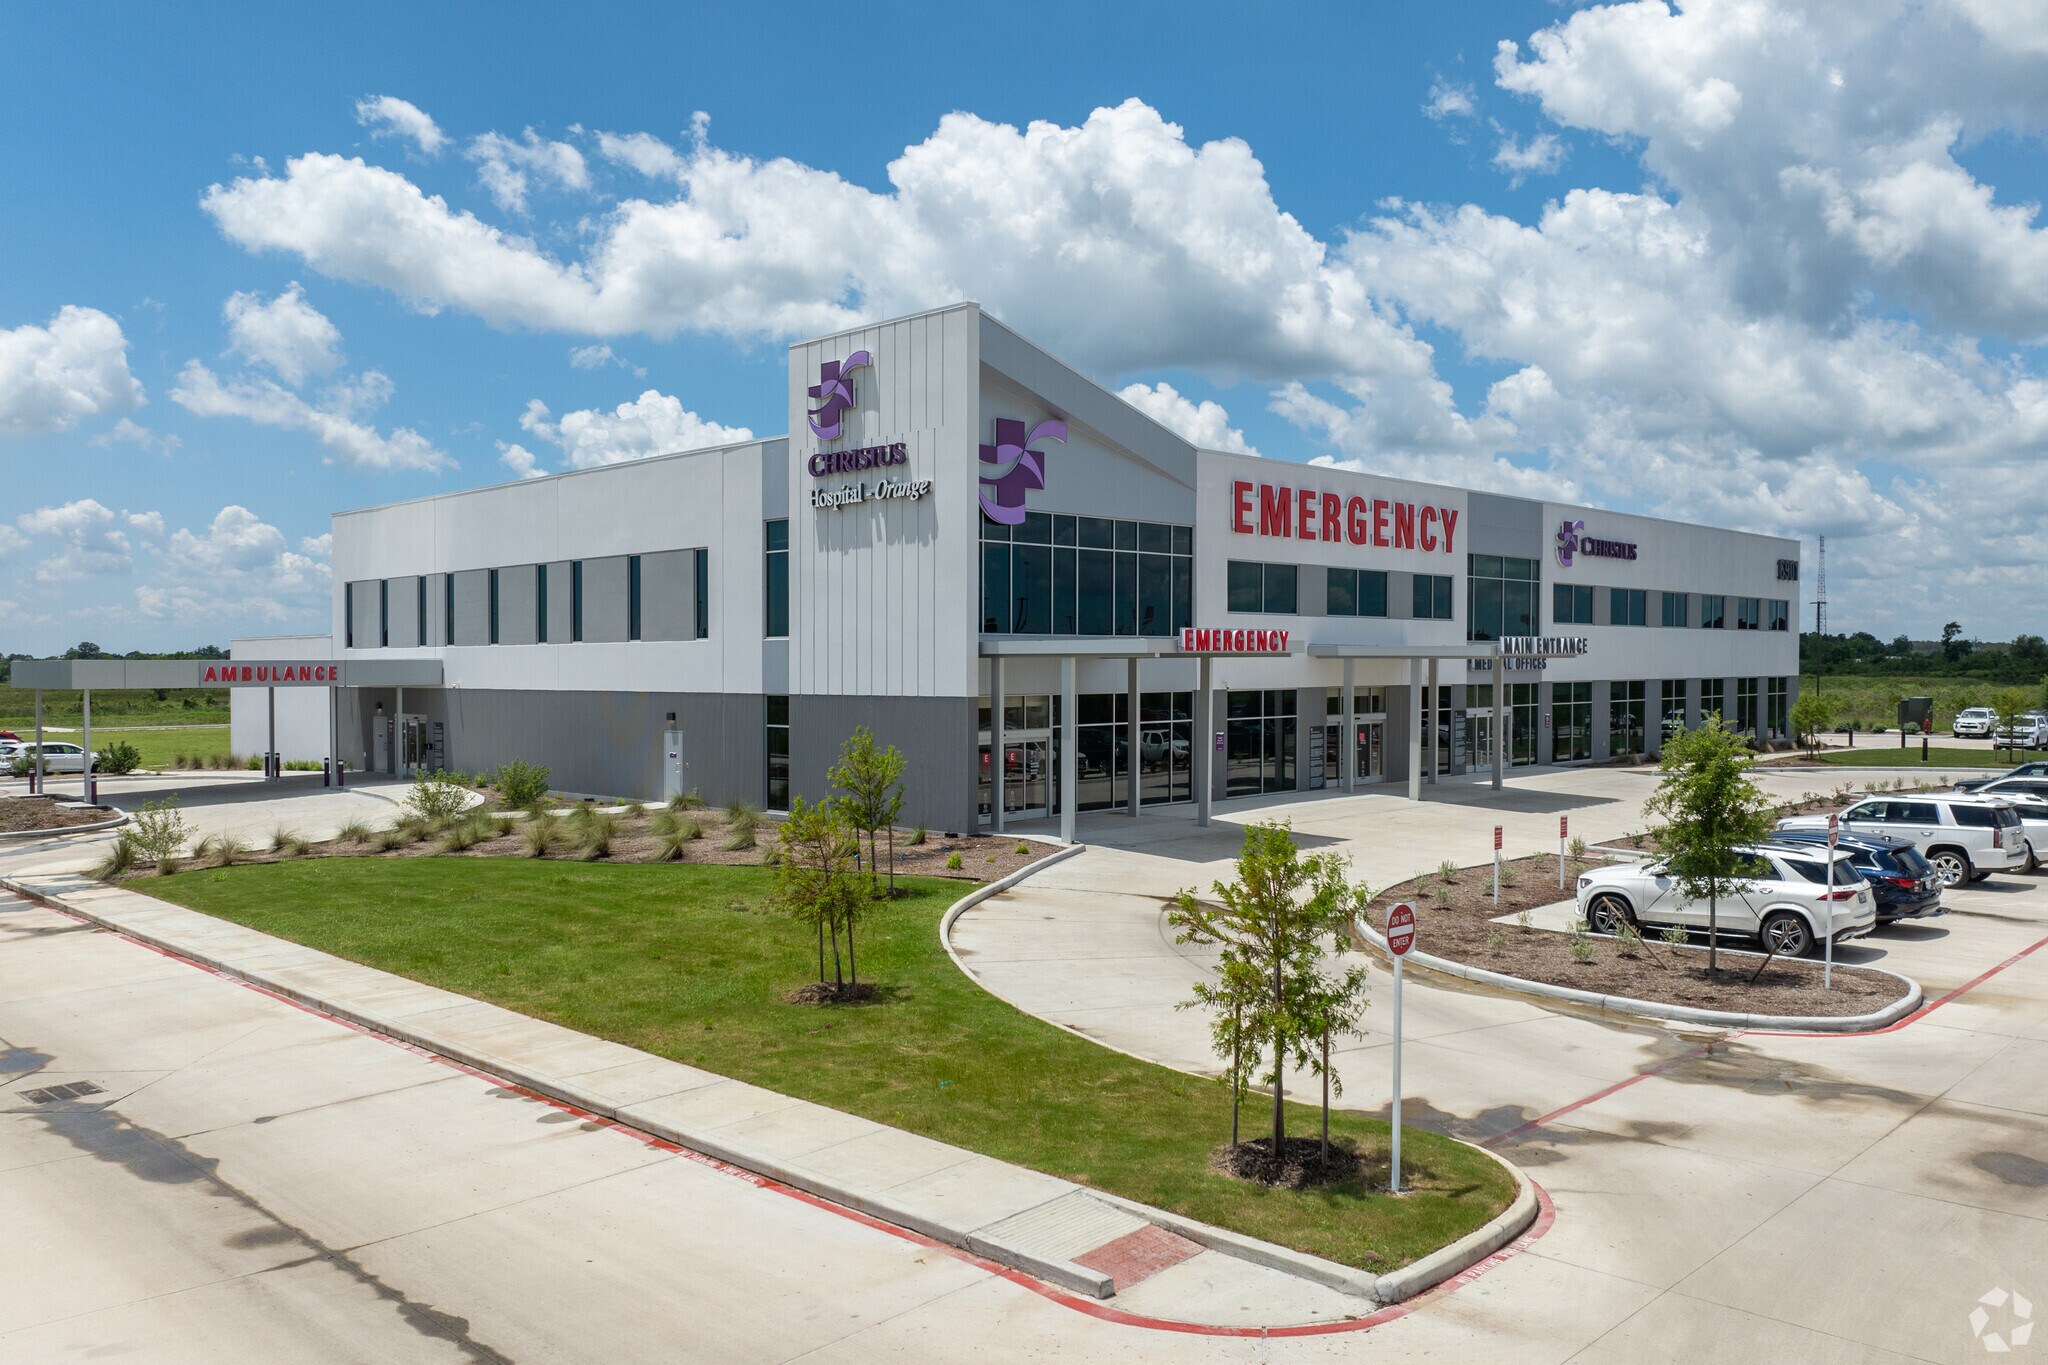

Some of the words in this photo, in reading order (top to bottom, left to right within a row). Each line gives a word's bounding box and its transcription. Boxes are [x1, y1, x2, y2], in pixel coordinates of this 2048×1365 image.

[810, 481, 864, 511] Hospital
[875, 478, 933, 501] Orange
[1232, 480, 1459, 554] EMERGENCY
[1184, 629, 1289, 652] EMERGENCY
[1503, 637, 1532, 654] MAIN
[1537, 637, 1588, 654] ENTRANCE
[1516, 657, 1547, 670] OFFICES
[204, 666, 338, 682] AMBULANCE
[1392, 916, 1399, 925] DO
[1400, 913, 1410, 923] NOT
[1393, 936, 1409, 947] ENTER
